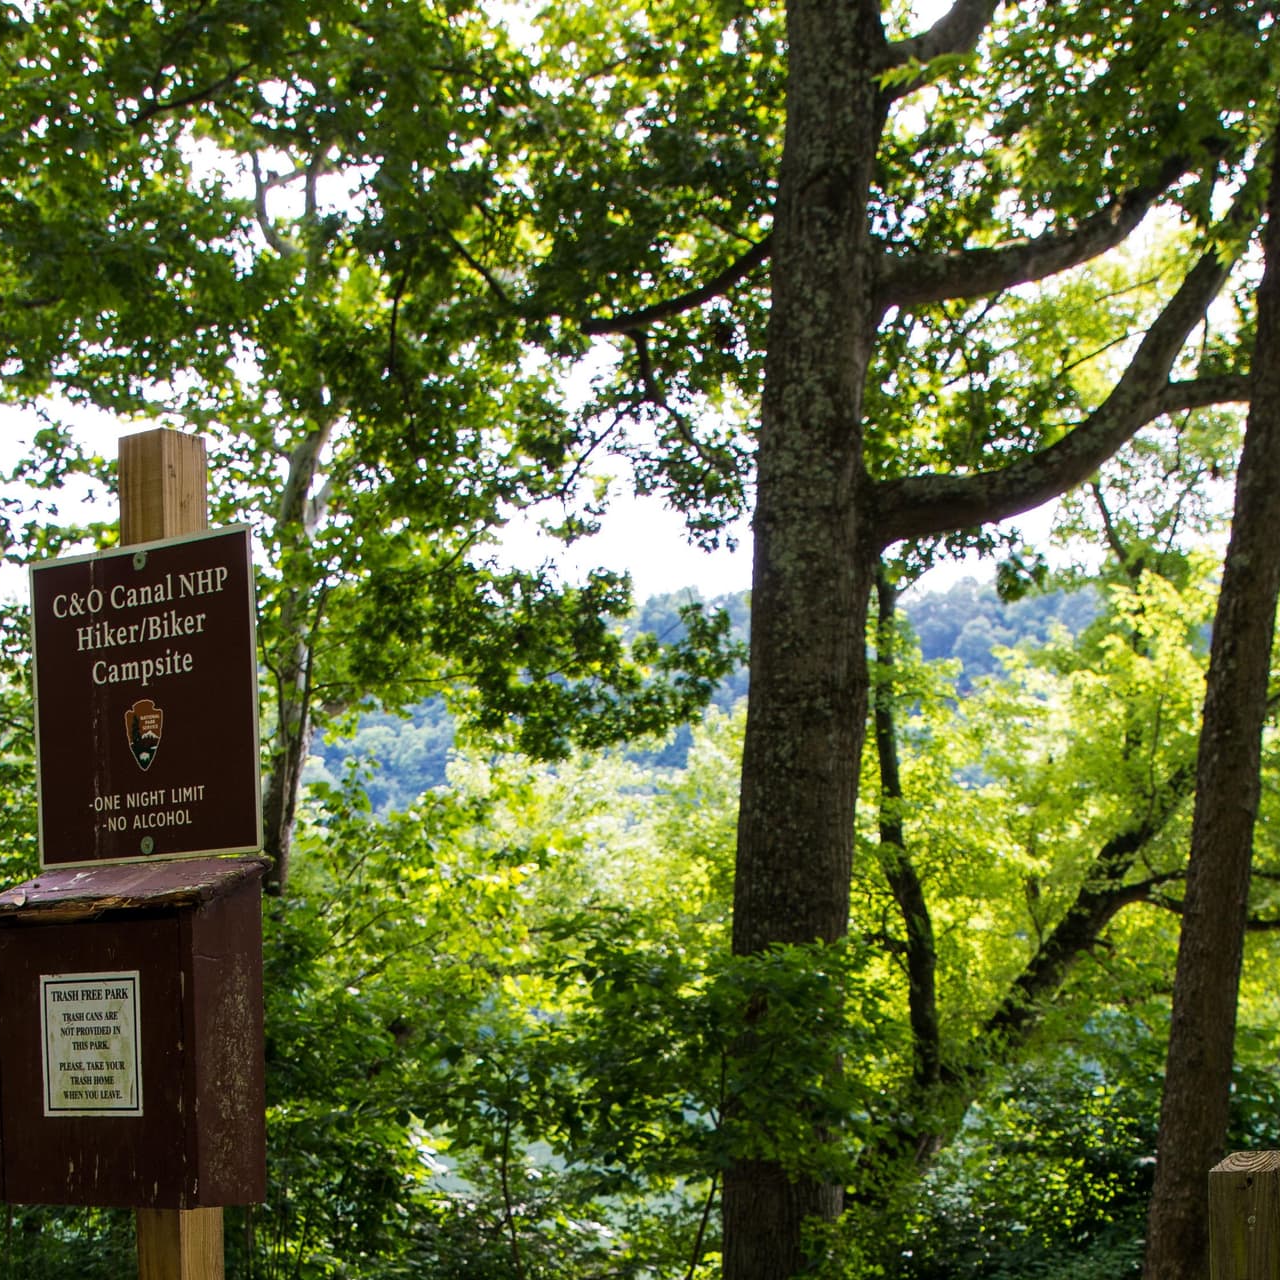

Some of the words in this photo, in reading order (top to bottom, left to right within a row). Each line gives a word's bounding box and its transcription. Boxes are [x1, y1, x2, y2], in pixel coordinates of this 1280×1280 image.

[53, 588, 104, 618] C&O
[111, 574, 173, 609] Canal
[178, 566, 228, 599] NHP
[76, 609, 207, 651] Hiker/Biker
[92, 648, 194, 686] Campsite
[126, 789, 166, 808] NIGHT
[171, 785, 205, 803] LIMIT
[133, 809, 193, 829] ALCOHOL
[51, 990, 79, 1002] TRASH
[81, 988, 103, 1001] FREE
[105, 988, 128, 1000] PARK
[62, 1012, 85, 1022] TRASH
[85, 1011, 103, 1022] CANS
[104, 1011, 119, 1021] ARE
[60, 1026, 74, 1037] NOT
[76, 1026, 112, 1036] PROVIDED
[113, 1025, 121, 1035] IN
[72, 1041, 89, 1051] THIS
[89, 1040, 110, 1050] PARK.
[86, 1061, 104, 1071] TAKE
[105, 1060, 125, 1070] YOUR
[70, 1076, 92, 1085] TRASH
[93, 1075, 115, 1085] HOME
[63, 1090, 83, 1100] WHEN
[84, 1090, 100, 1100] YOU
[100, 1089, 123, 1100] LEAVE.
